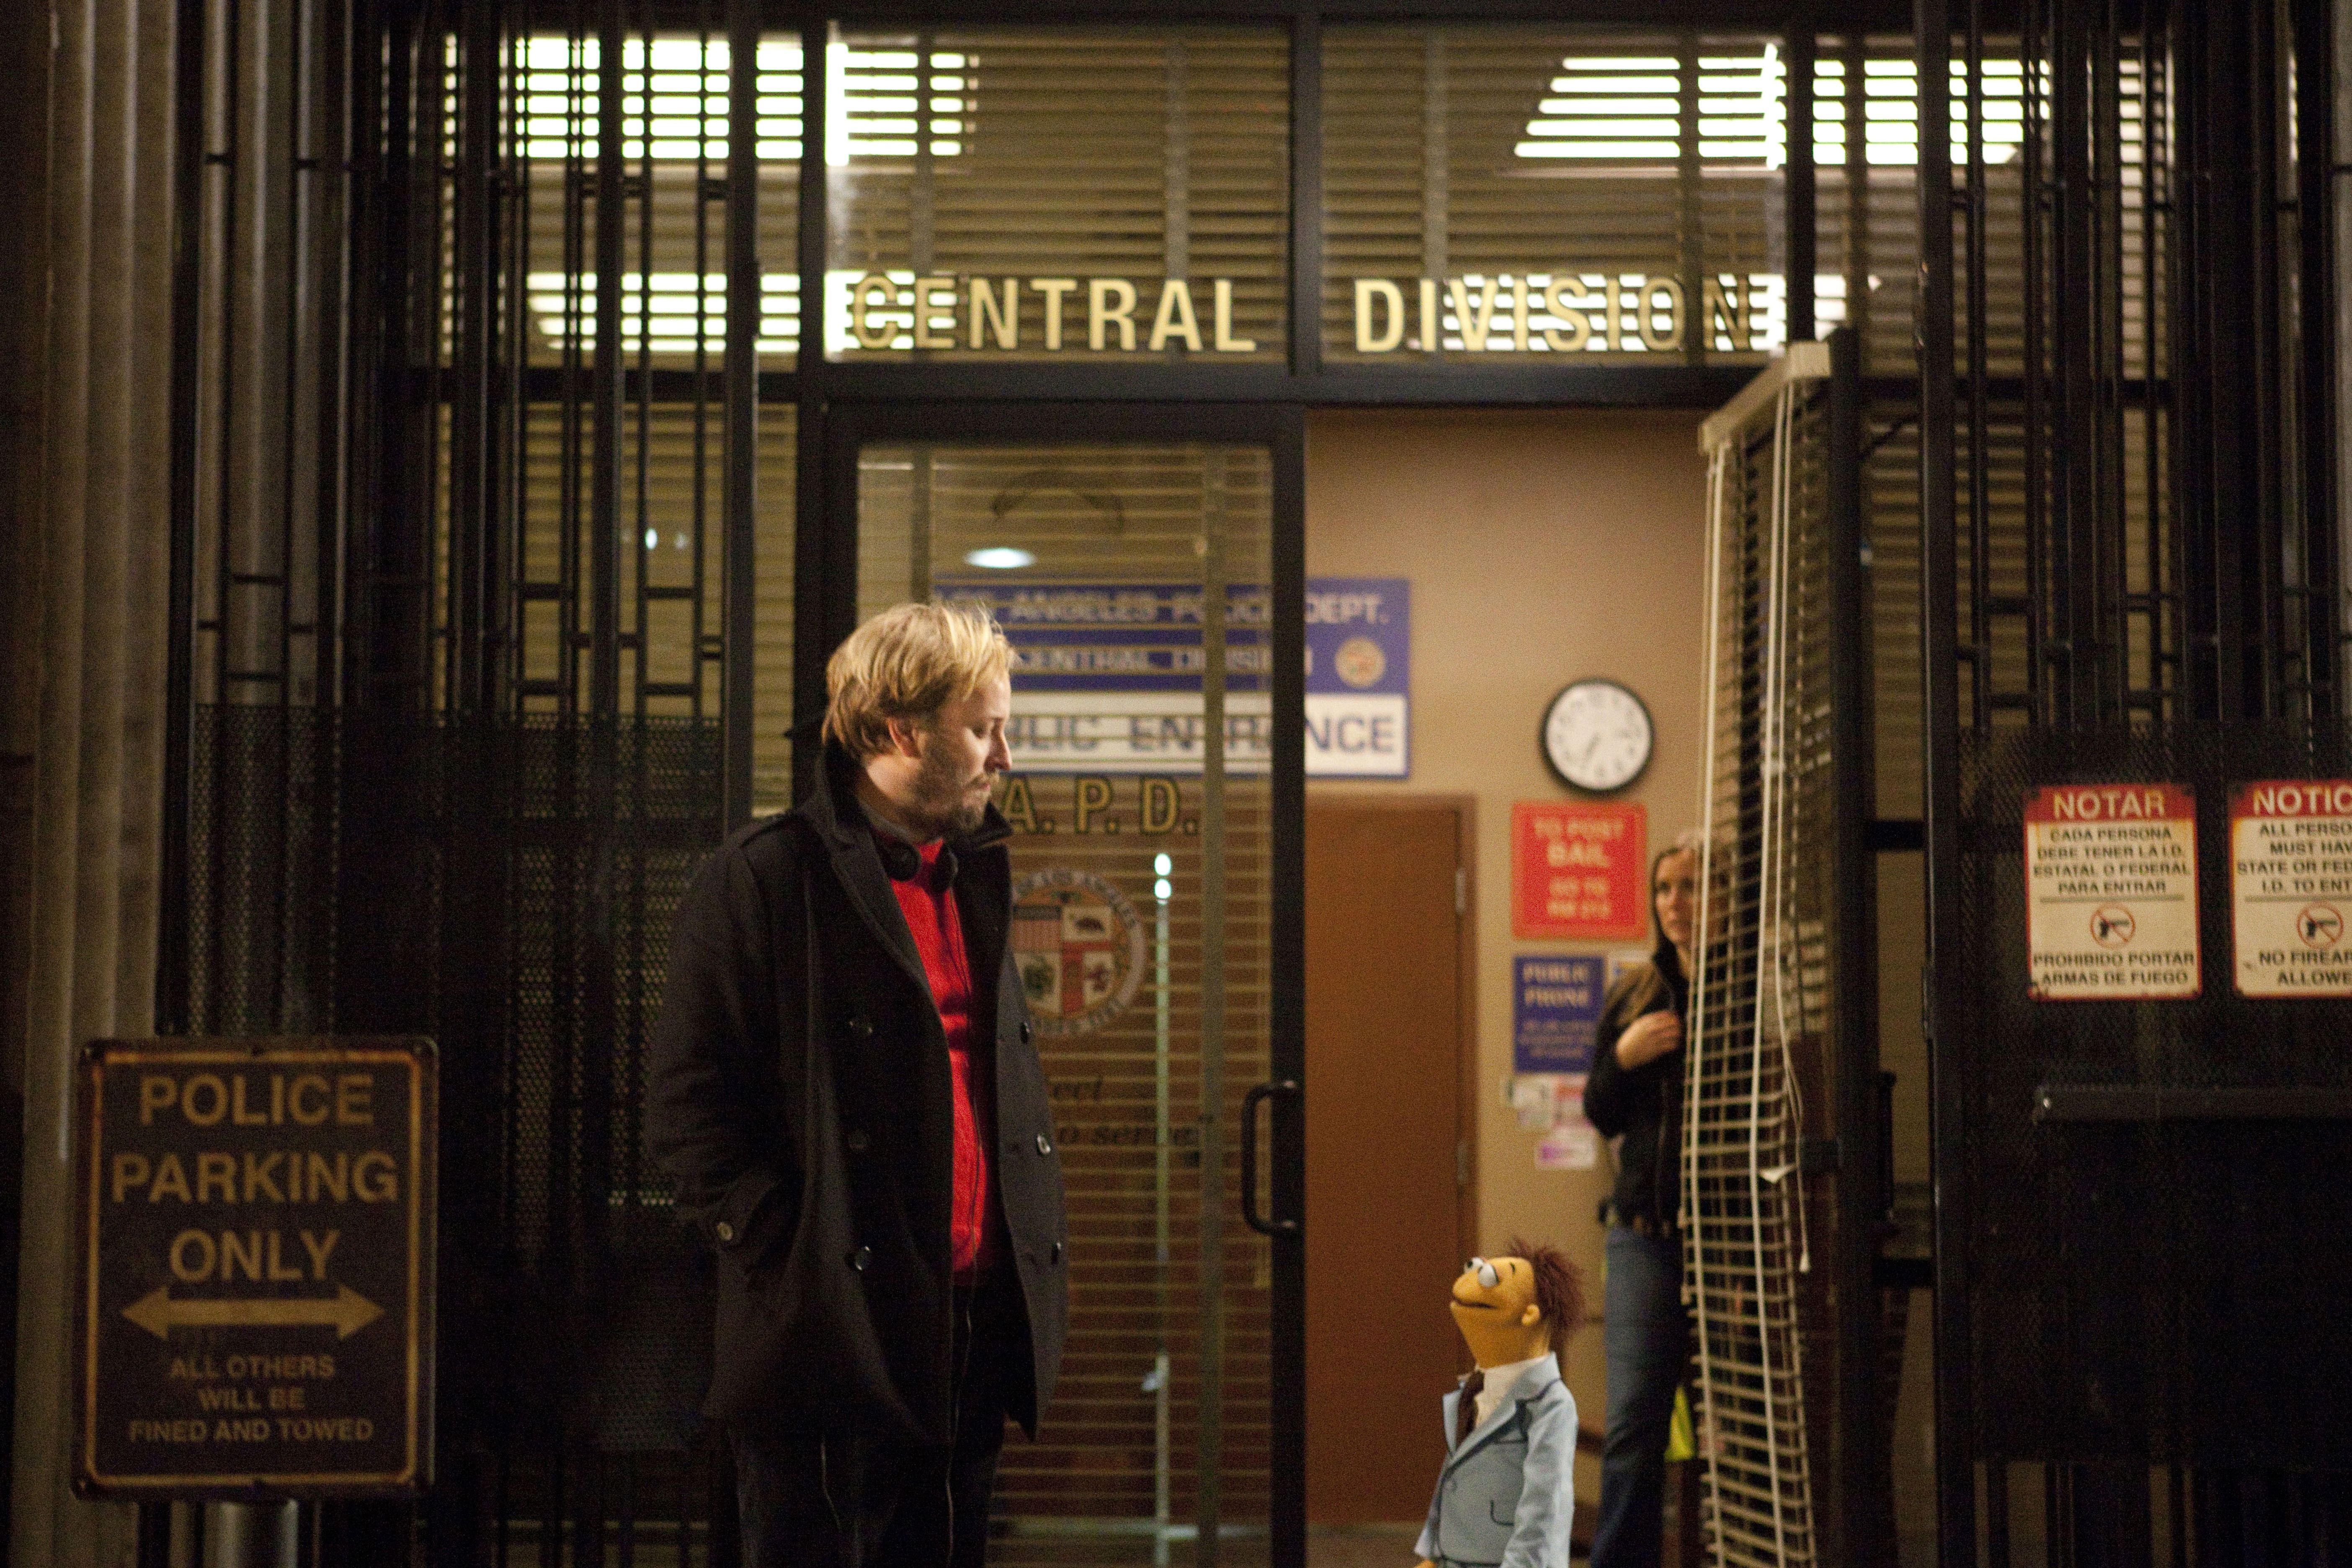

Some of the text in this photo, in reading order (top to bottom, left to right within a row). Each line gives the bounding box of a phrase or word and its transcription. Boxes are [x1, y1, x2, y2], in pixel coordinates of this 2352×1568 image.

[853, 274, 1750, 352] CENTRAL DIVISION
[2053, 790, 2165, 819] NOTAR
[2050, 825, 2171, 841] CADA PERSONA
[2260, 823, 2288, 835] ALL
[2037, 846, 2077, 860] DEBE
[2084, 846, 2134, 859] TENER
[2138, 845, 2159, 858] LA
[2269, 841, 2314, 854] MUST
[2033, 864, 2098, 877] ESTATAL
[2119, 863, 2190, 876] FEDERAL
[2238, 861, 2288, 874] STATE
[2293, 860, 2317, 873] OR
[2058, 880, 2167, 894] PARA ENTRAR
[2294, 879, 2315, 892] TO
[2033, 952, 2195, 965] PROHIBIDO PORTAR
[2259, 950, 2285, 964] NO
[2041, 971, 2188, 985] ARMAS DE FUEGO
[139, 1074, 375, 1126] POLICE
[112, 1151, 397, 1203] PARKING
[170, 1229, 340, 1282] ONLY
[170, 1354, 335, 1380] ALL OTHERS
[197, 1386, 305, 1411] WILL BE
[129, 1417, 374, 1443] FINED AND TOWED
